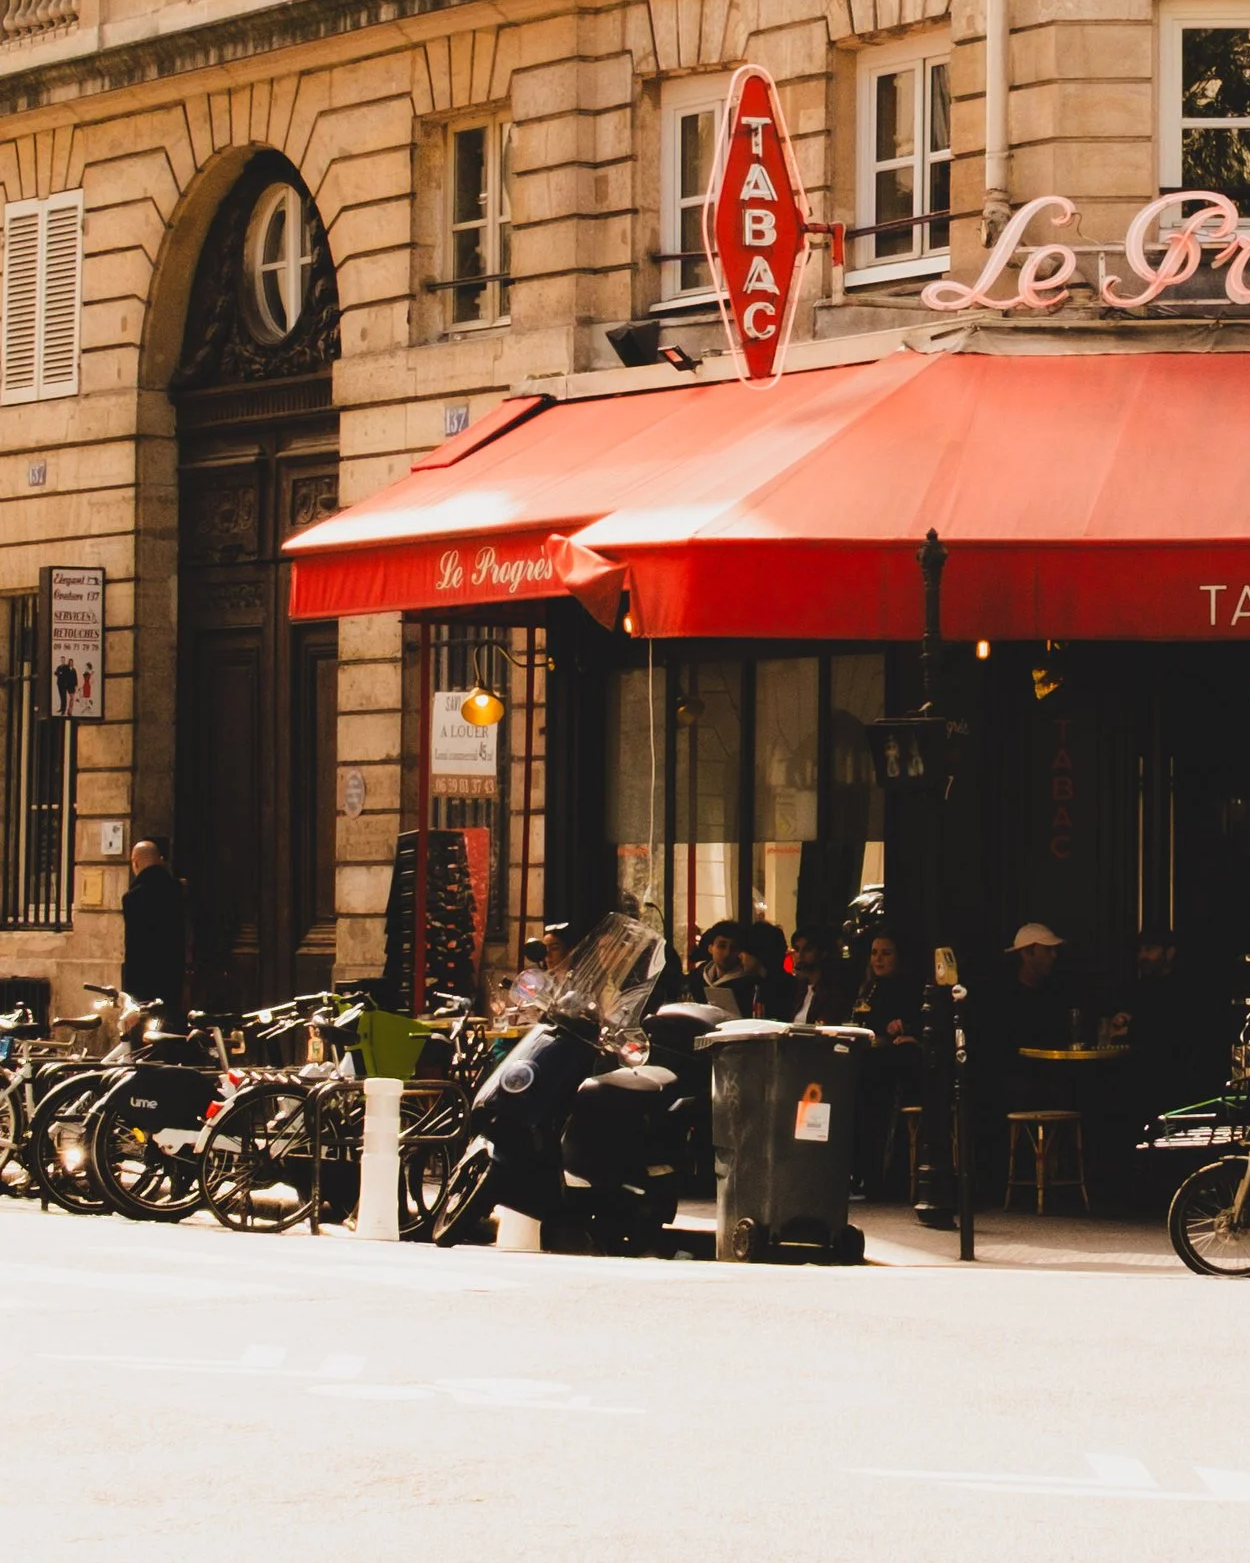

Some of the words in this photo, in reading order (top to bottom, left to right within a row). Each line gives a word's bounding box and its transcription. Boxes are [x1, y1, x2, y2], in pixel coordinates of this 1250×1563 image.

[740, 116, 778, 341] TABAC
[921, 195, 1077, 311] Le
[446, 407, 468, 434] 137
[435, 549, 463, 590] Le
[471, 545, 553, 594] Progrès
[53, 628, 100, 639] RETOUCHES
[54, 610, 91, 621] SERVICES
[441, 725, 448, 738] A
[450, 724, 489, 738] LOUER
[1050, 718, 1074, 860] TABAC
